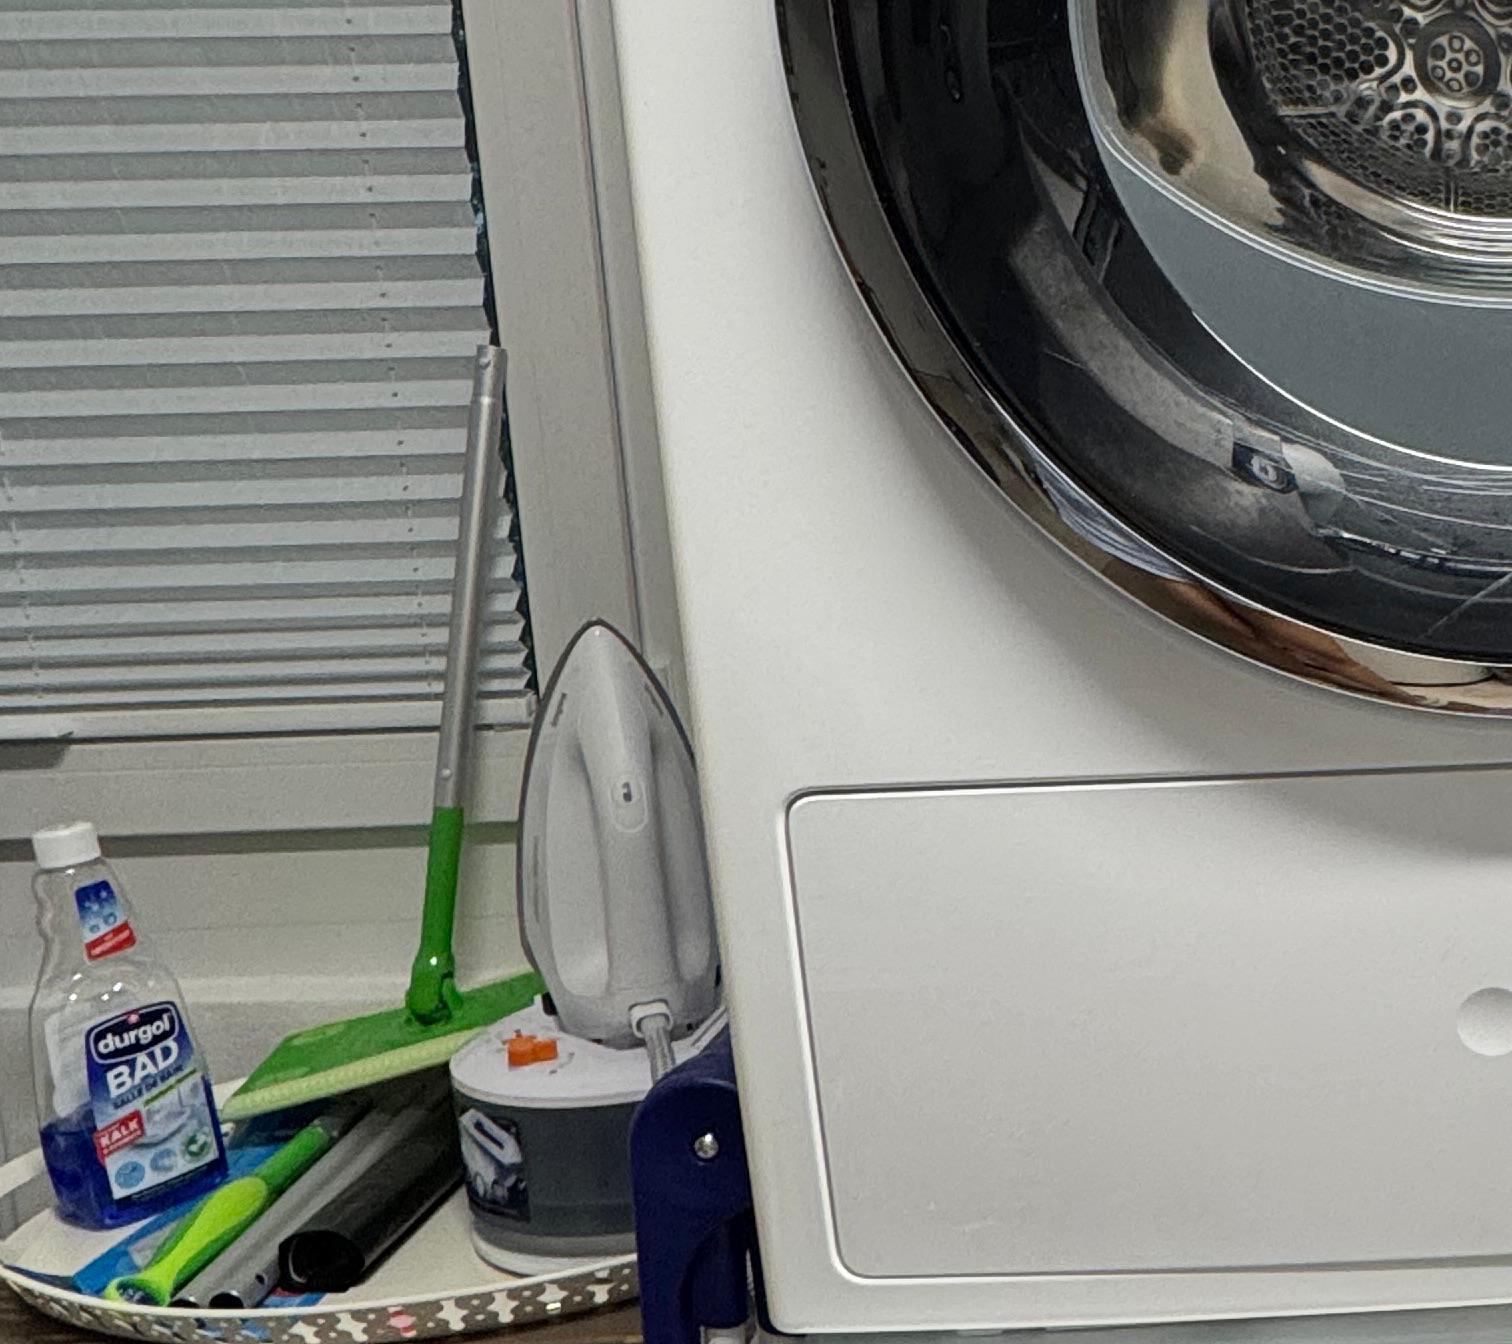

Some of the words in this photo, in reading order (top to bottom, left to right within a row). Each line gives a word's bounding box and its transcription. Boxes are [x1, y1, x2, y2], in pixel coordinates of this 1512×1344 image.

[97, 1012, 171, 1055] durgol
[107, 1039, 178, 1098] BAD
[100, 1118, 141, 1148] KALK
